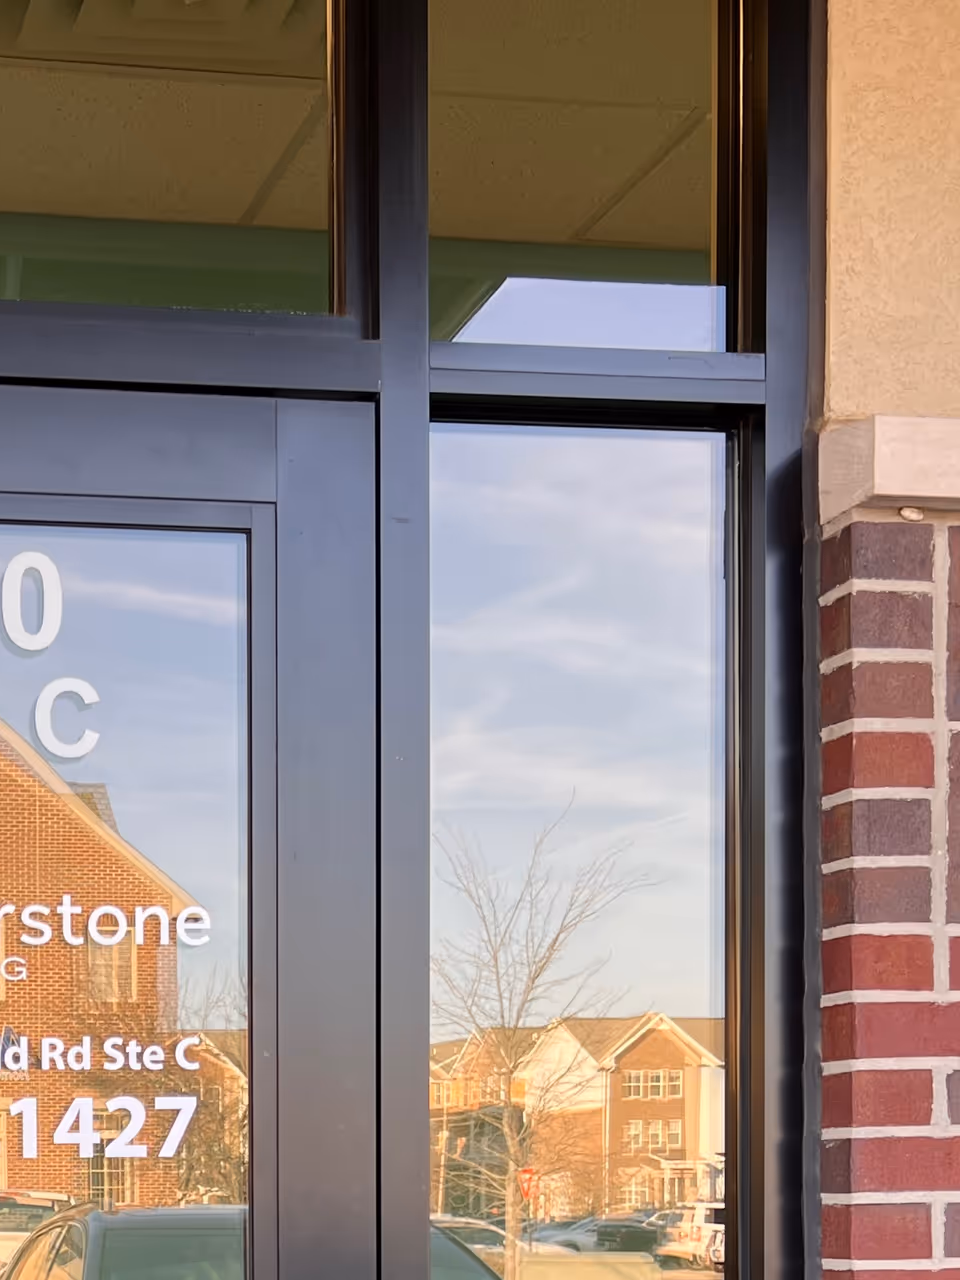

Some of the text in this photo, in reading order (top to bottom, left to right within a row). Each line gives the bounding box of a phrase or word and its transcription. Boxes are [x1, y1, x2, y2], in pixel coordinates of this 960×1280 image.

[35, 677, 101, 758] C
[41, 1035, 91, 1070] Rd
[103, 1036, 165, 1070] Ste
[175, 1036, 201, 1070] C
